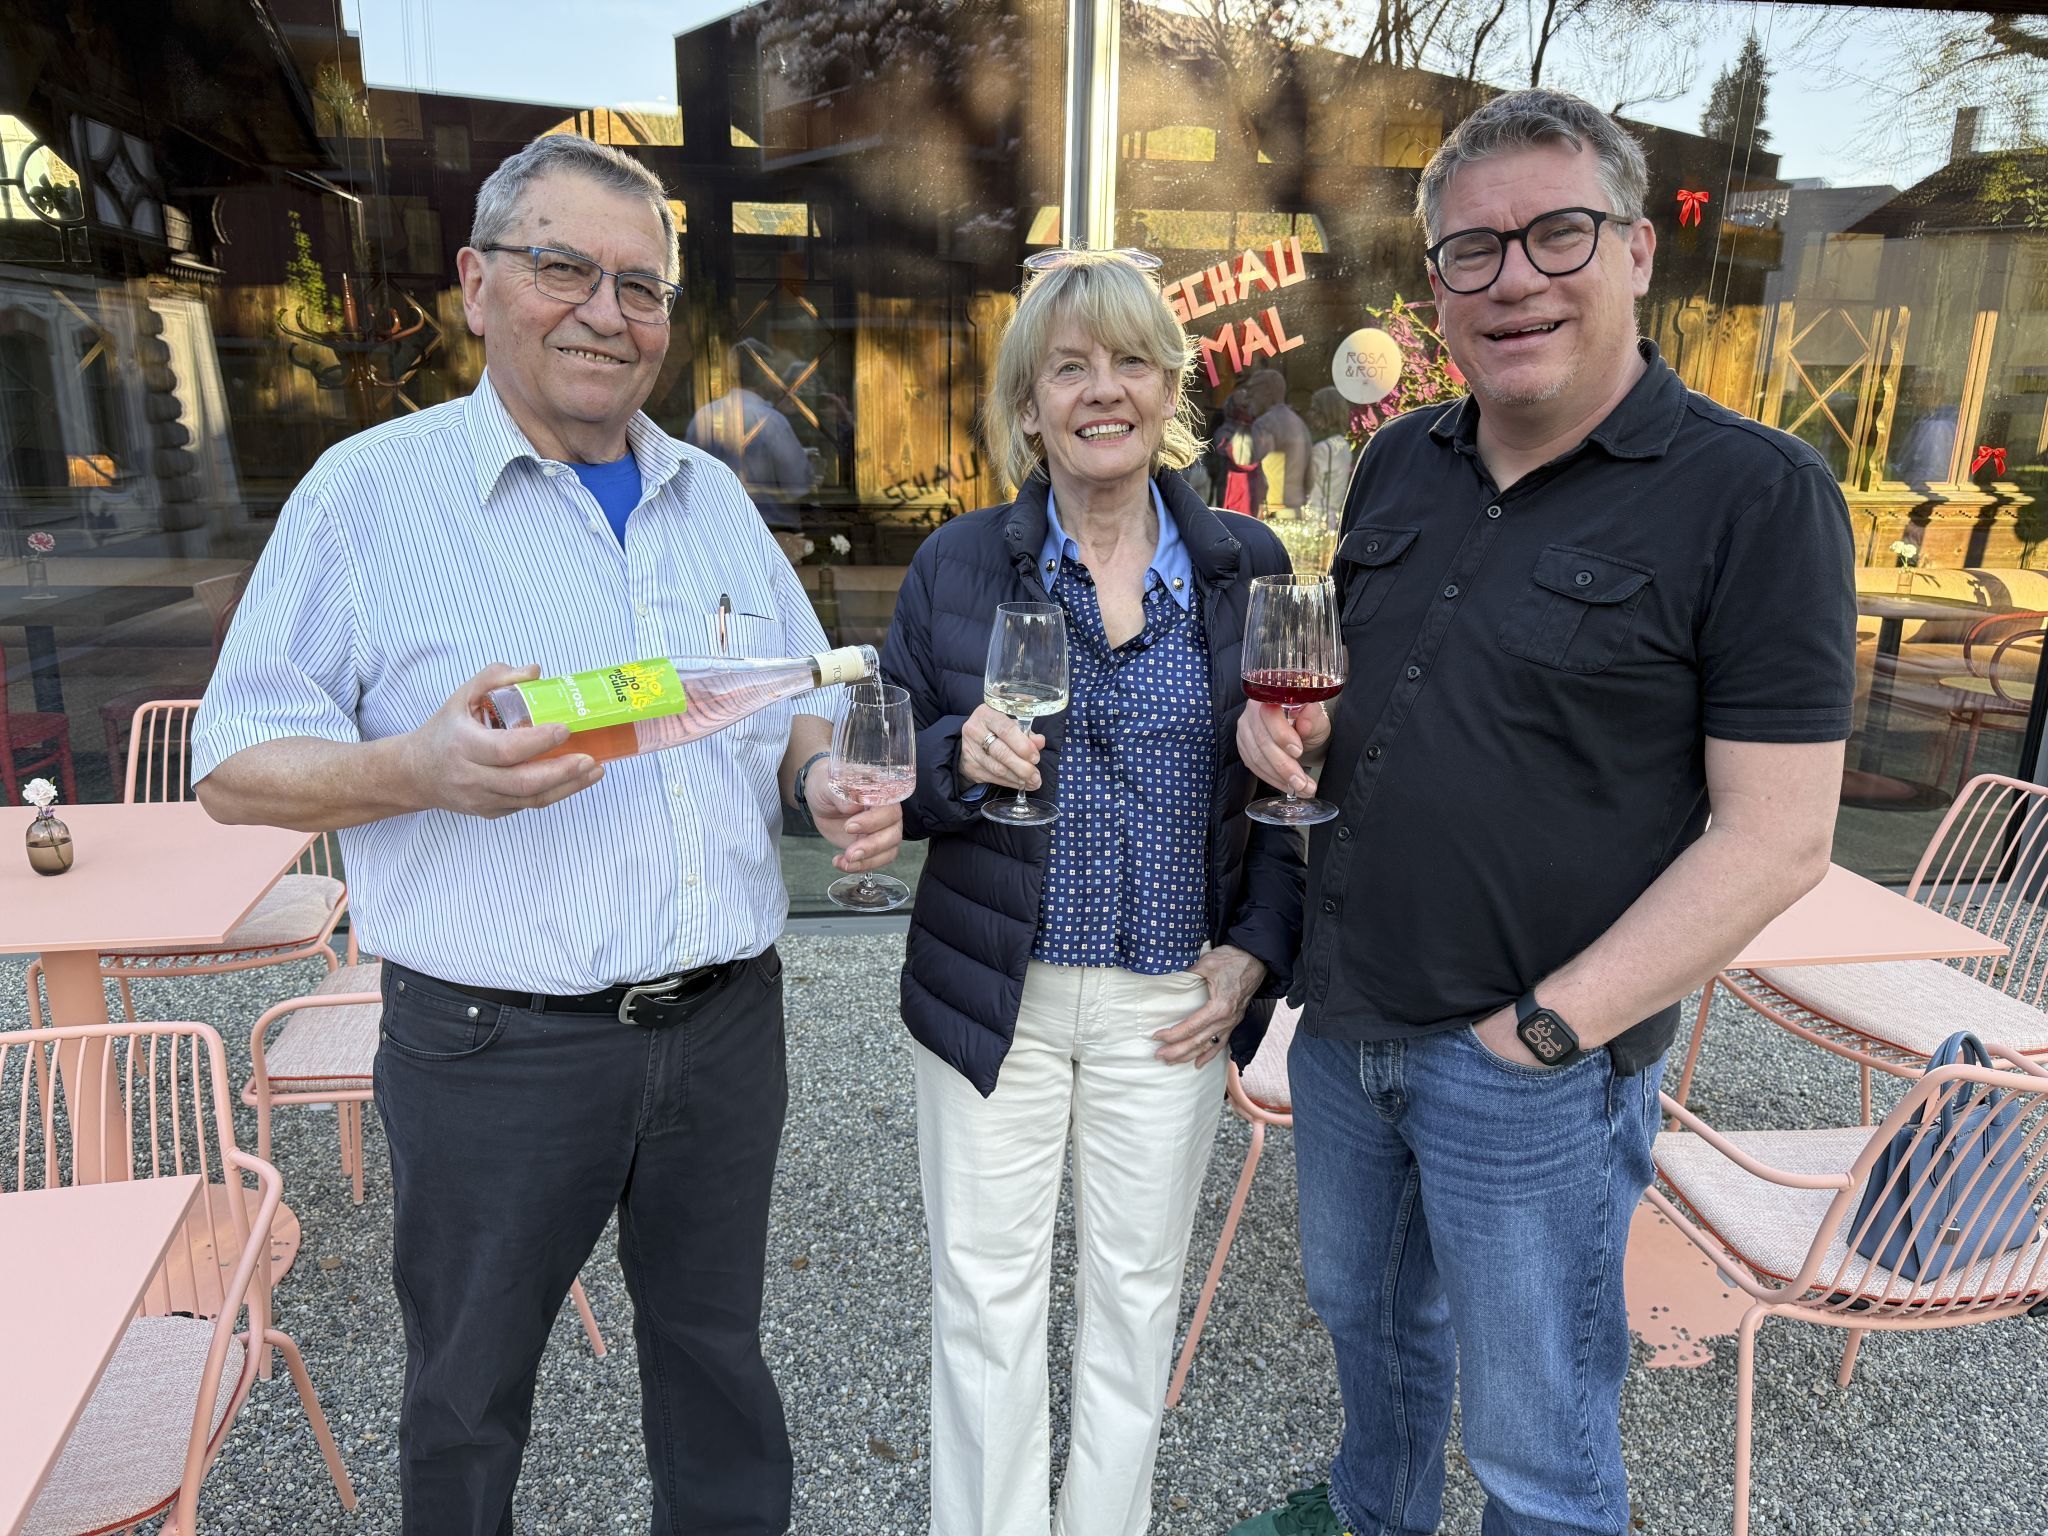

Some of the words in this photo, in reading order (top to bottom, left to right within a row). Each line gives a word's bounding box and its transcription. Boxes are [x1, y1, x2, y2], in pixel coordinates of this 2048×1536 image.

[1162, 236, 1306, 325] SCHAU
[1199, 306, 1305, 388] MAL
[1346, 352, 1388, 365] ROSA
[570, 687, 591, 716] rosé
